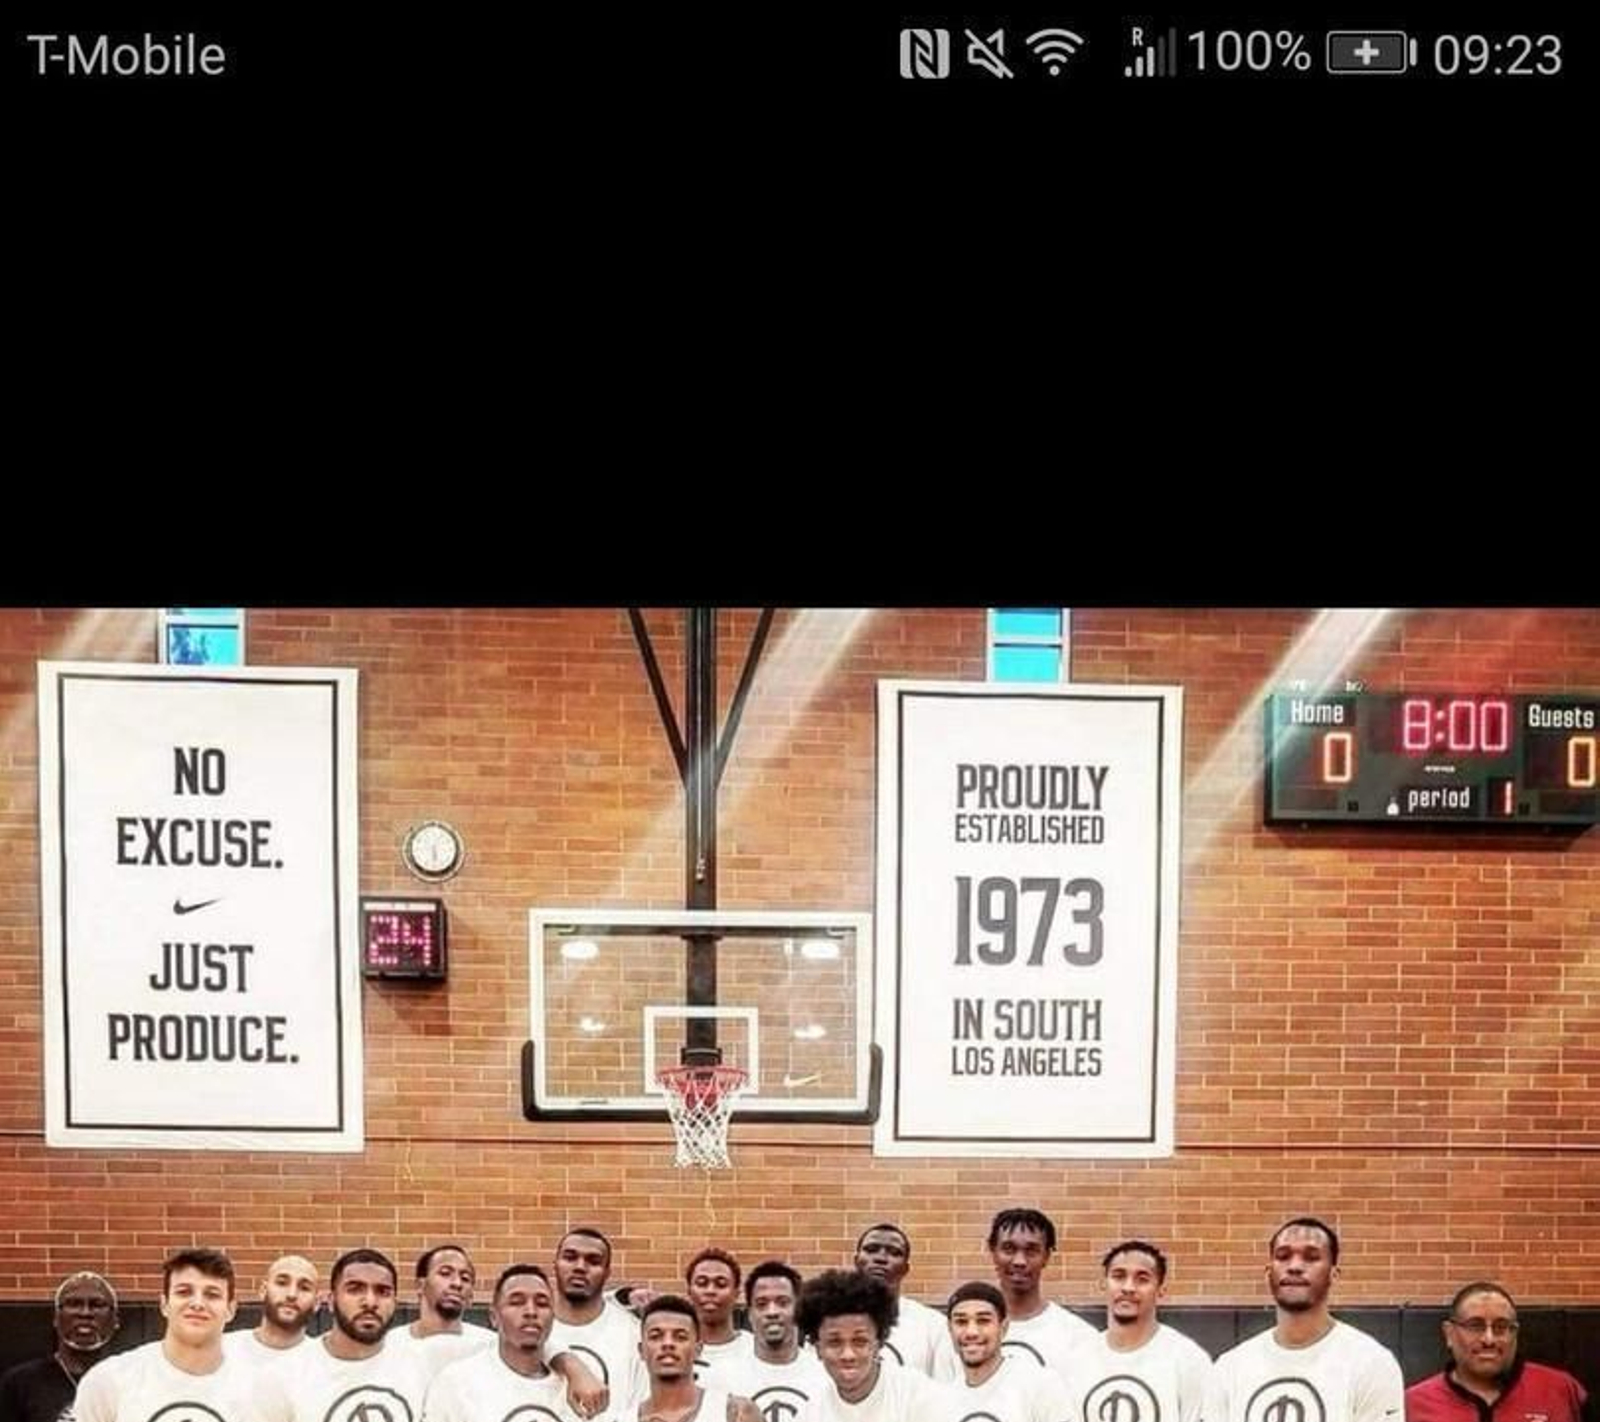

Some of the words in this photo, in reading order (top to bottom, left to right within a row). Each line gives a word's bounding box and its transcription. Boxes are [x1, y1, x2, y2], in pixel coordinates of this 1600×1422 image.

[1290, 699, 1344, 724] Home
[1404, 700, 1508, 751] 8:00
[1528, 703, 1595, 729] Guests
[173, 747, 226, 796] NO
[1324, 732, 1353, 783] 0
[1567, 735, 1597, 788] 0
[956, 763, 1110, 811] PROUDLY
[1408, 786, 1471, 809] period
[1505, 781, 1513, 815] 1
[116, 816, 284, 869] EXCUSE.
[955, 814, 1104, 845] ESTABLISHED
[369, 914, 432, 967] 24
[955, 876, 1104, 967] 1973
[149, 942, 254, 993] JUST
[107, 1013, 299, 1064] PRODUCE.
[953, 999, 983, 1040] IN
[994, 999, 1102, 1041] SOUTH
[952, 1046, 994, 1075] LOS
[1001, 1047, 1101, 1077] ANGELES
